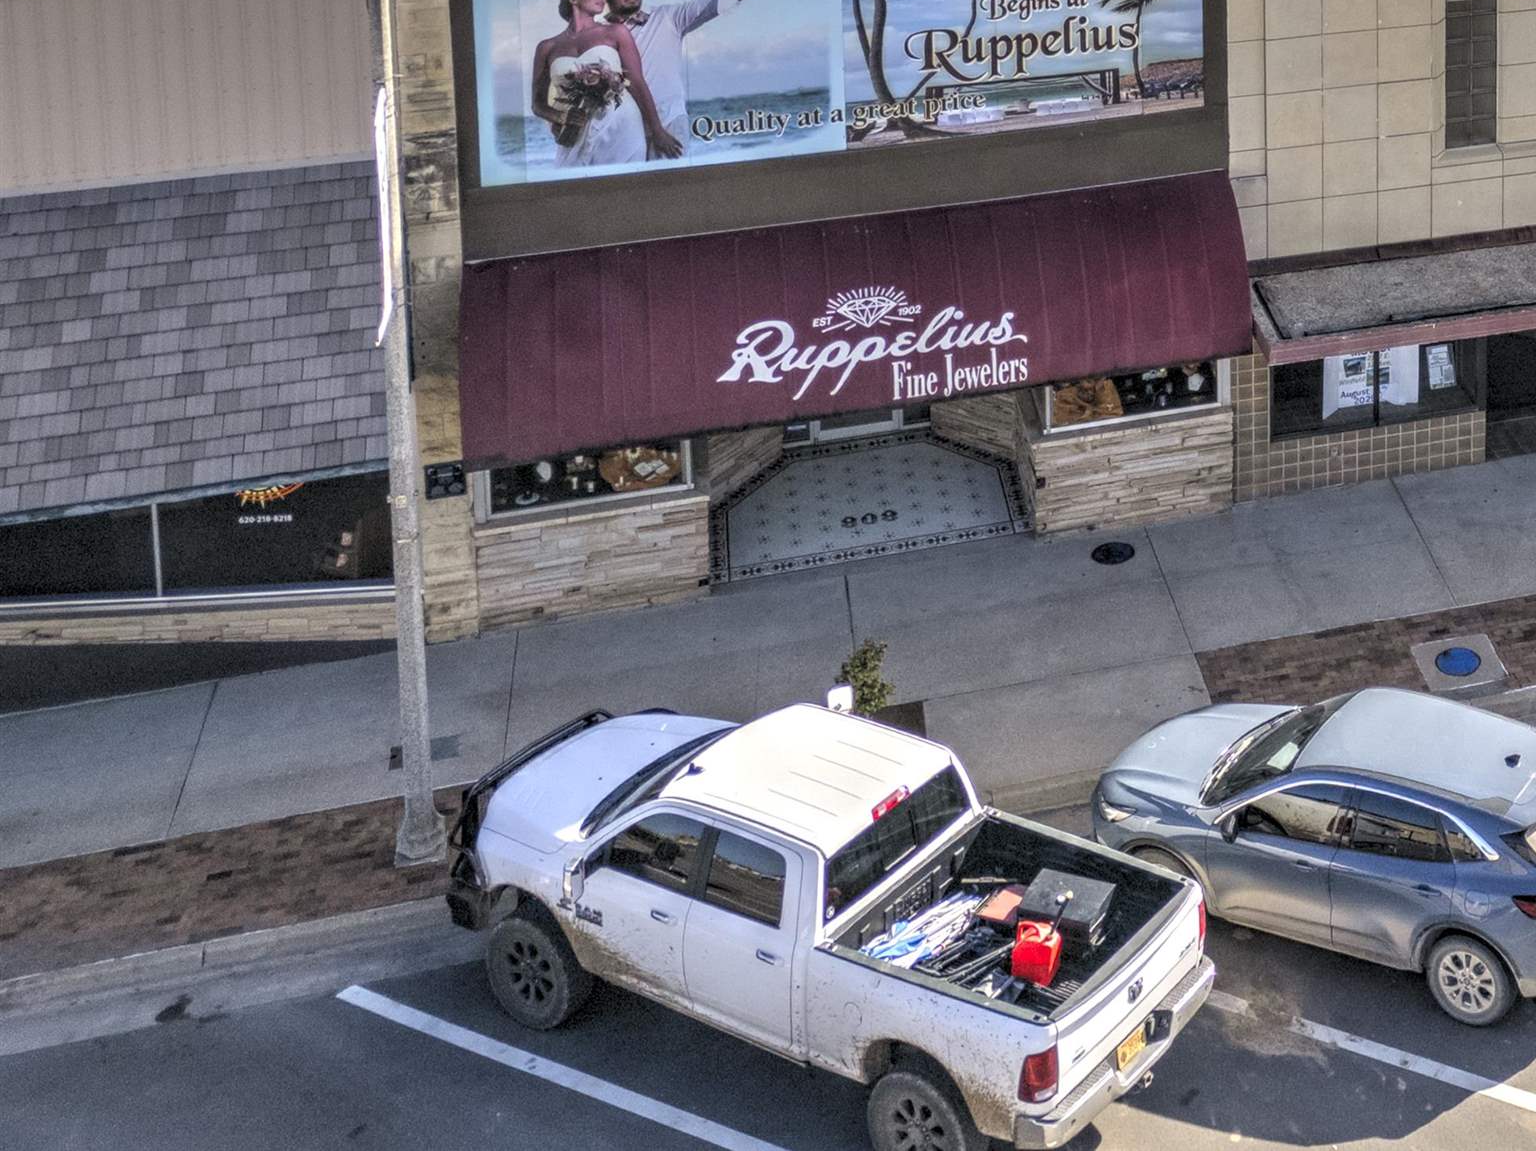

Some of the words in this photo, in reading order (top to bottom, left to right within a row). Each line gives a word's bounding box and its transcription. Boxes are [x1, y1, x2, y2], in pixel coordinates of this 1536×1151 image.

[904, 16, 1138, 82] Ruppelius
[691, 110, 790, 141] Quality
[797, 106, 822, 127] at
[829, 108, 844, 123] a
[852, 97, 917, 128] great
[922, 89, 986, 123] price
[812, 316, 833, 328] EST
[897, 304, 922, 316] 1902
[716, 305, 1028, 401] Ruppelius
[891, 358, 938, 401] Fine
[944, 348, 1029, 397] Jewelers
